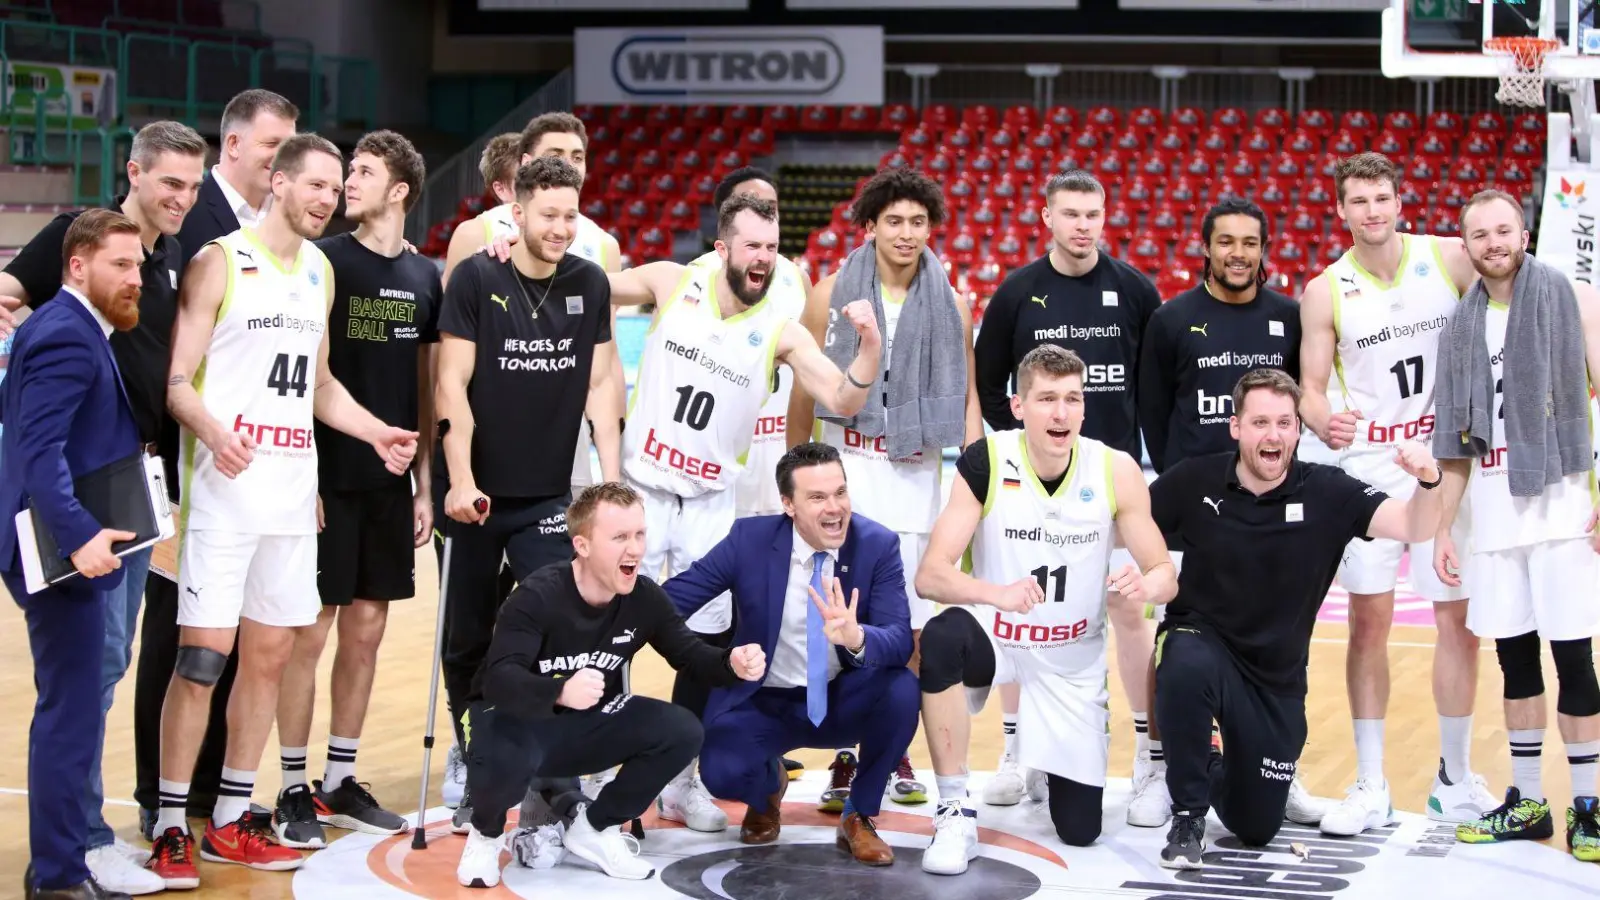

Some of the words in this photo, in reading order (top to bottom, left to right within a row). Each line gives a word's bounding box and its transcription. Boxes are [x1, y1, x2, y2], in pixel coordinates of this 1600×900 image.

[628, 50, 828, 83] WITRON
[379, 287, 416, 300] BAYREUTH
[247, 313, 284, 331] medi
[348, 296, 417, 323] BASKET
[346, 318, 389, 342] BALL
[1034, 324, 1068, 340] medi
[1069, 323, 1122, 340] bayreuth
[1356, 326, 1392, 350] medi
[1392, 314, 1449, 339] bayreuth
[504, 338, 555, 354] HEROES
[557, 338, 574, 352] OF
[1490, 347, 1504, 365] ed
[665, 339, 701, 363] medi
[699, 351, 751, 390] bayreuth
[1197, 351, 1232, 370] medi
[1232, 352, 1284, 369] bayreuth
[267, 353, 309, 398] 44
[1389, 354, 1424, 400] 17
[673, 384, 716, 432] 10
[1367, 414, 1436, 444] bros
[1005, 527, 1041, 542] medi
[1045, 530, 1100, 549] bayreuth
[1030, 565, 1068, 604] 11
[993, 611, 1088, 642] brose
